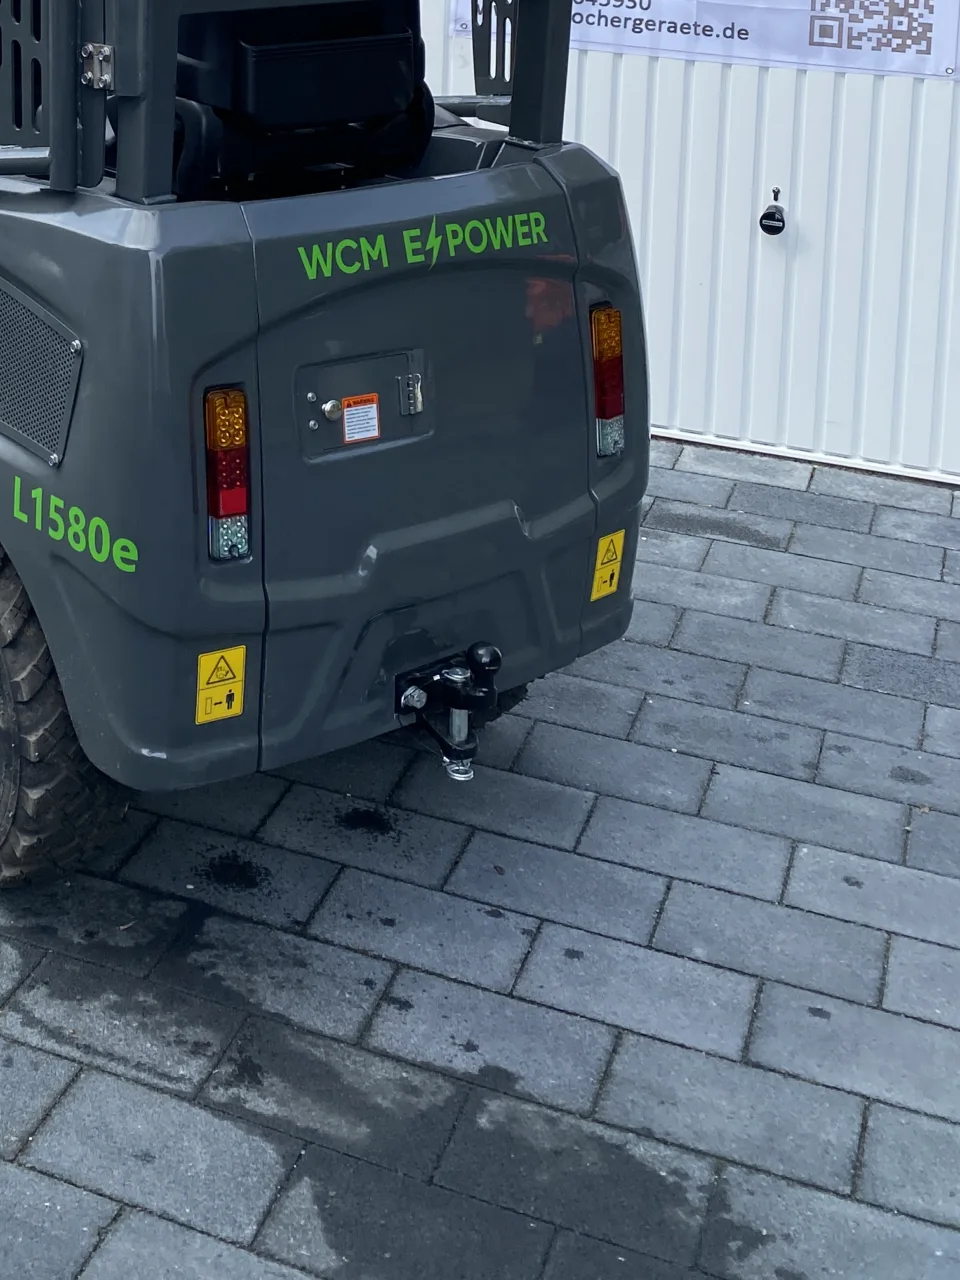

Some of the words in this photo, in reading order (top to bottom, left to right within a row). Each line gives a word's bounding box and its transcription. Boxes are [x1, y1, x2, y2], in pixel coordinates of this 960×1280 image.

[571, 9, 750, 41] ochergeraete.de
[297, 234, 389, 280] WCM
[13, 475, 139, 573] L1580e
